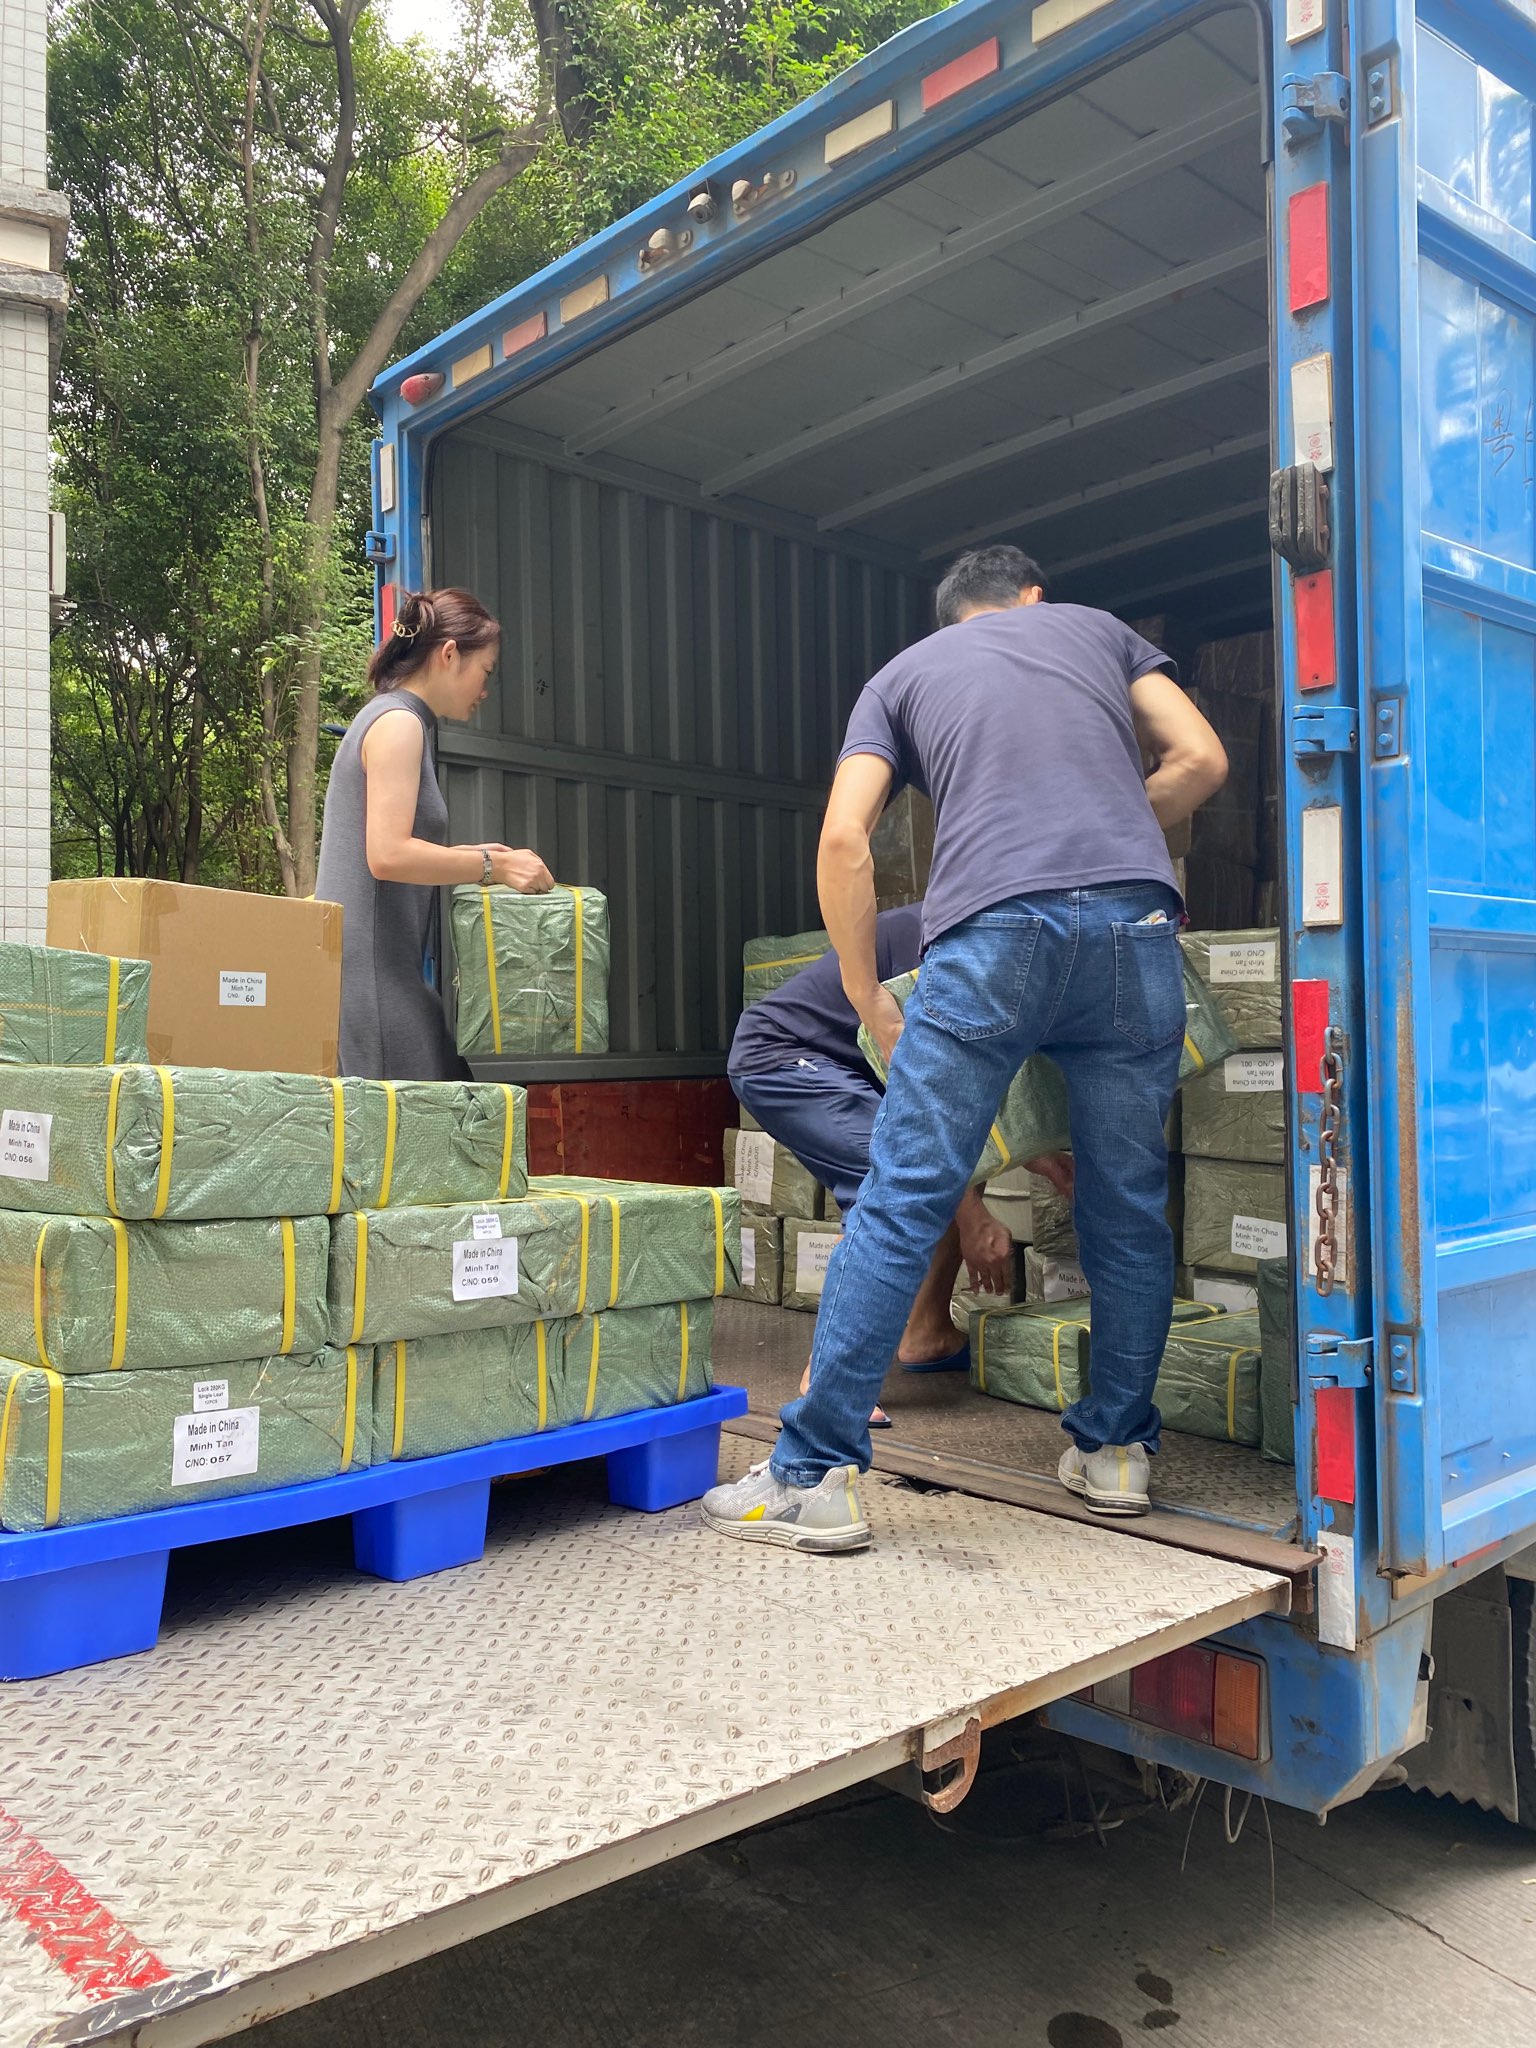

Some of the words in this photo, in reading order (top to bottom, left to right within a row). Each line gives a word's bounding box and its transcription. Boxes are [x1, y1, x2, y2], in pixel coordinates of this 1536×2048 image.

[1235, 959, 1247, 967] Tan
[245, 994, 255, 1003] 60
[8, 1119, 20, 1132] Made
[26, 1121, 41, 1134] China
[8, 1138, 22, 1147] Minh
[23, 1140, 35, 1149] Tan
[1235, 1222, 1253, 1232] Made
[1261, 1227, 1279, 1237] China
[1235, 1232, 1251, 1241] Minh
[1252, 1235, 1264, 1243] Tan
[809, 1241, 824, 1249] Made
[463, 1248, 479, 1260] Made
[480, 1248, 486, 1258] in
[486, 1246, 503, 1257] China
[815, 1253, 829, 1261] Minh
[464, 1265, 483, 1273] Minh
[485, 1263, 500, 1271] Tan
[1058, 1272, 1078, 1284] Made
[187, 1422, 208, 1437] Made
[209, 1421, 217, 1434] in
[218, 1419, 240, 1432] China
[189, 1442, 213, 1452] Minh
[216, 1439, 234, 1448] Tan
[210, 1454, 232, 1464] 057
